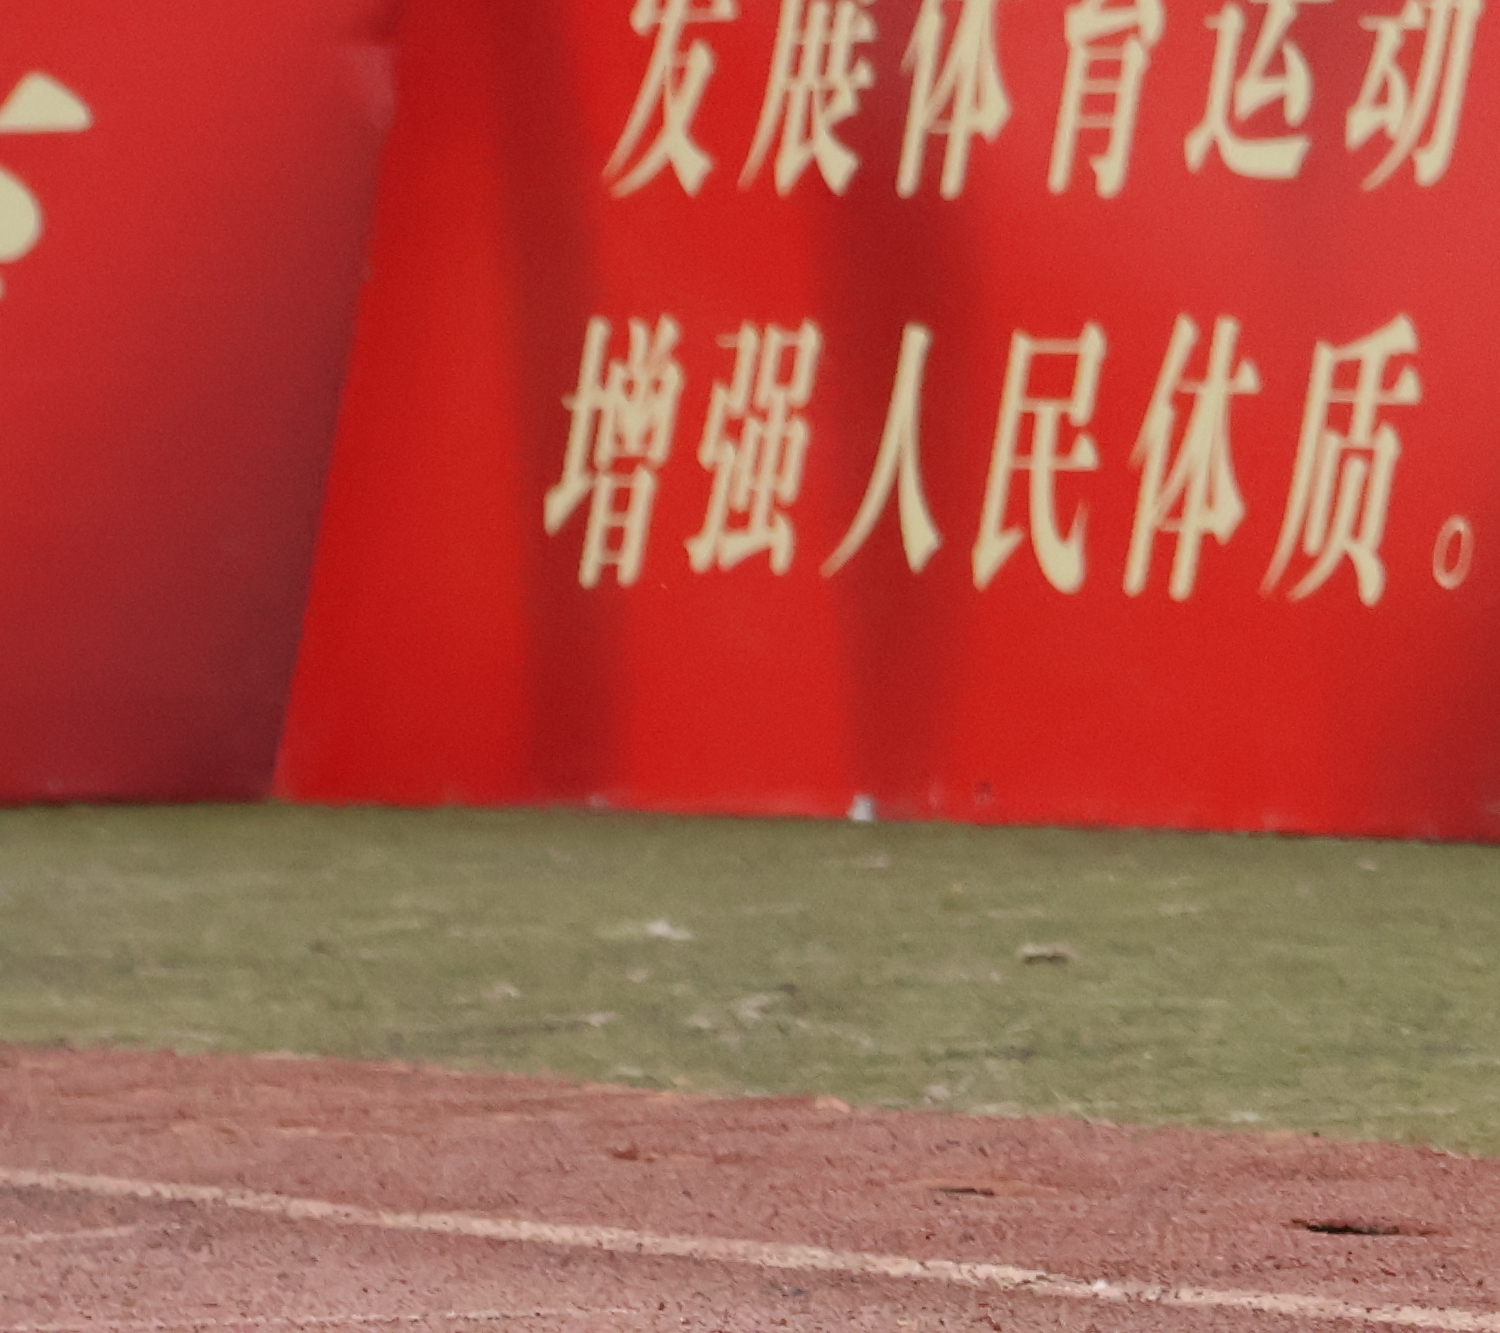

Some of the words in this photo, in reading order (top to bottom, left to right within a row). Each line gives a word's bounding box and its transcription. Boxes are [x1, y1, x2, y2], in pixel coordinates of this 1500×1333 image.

[542, 309, 1474, 609] 增强人民体质。
